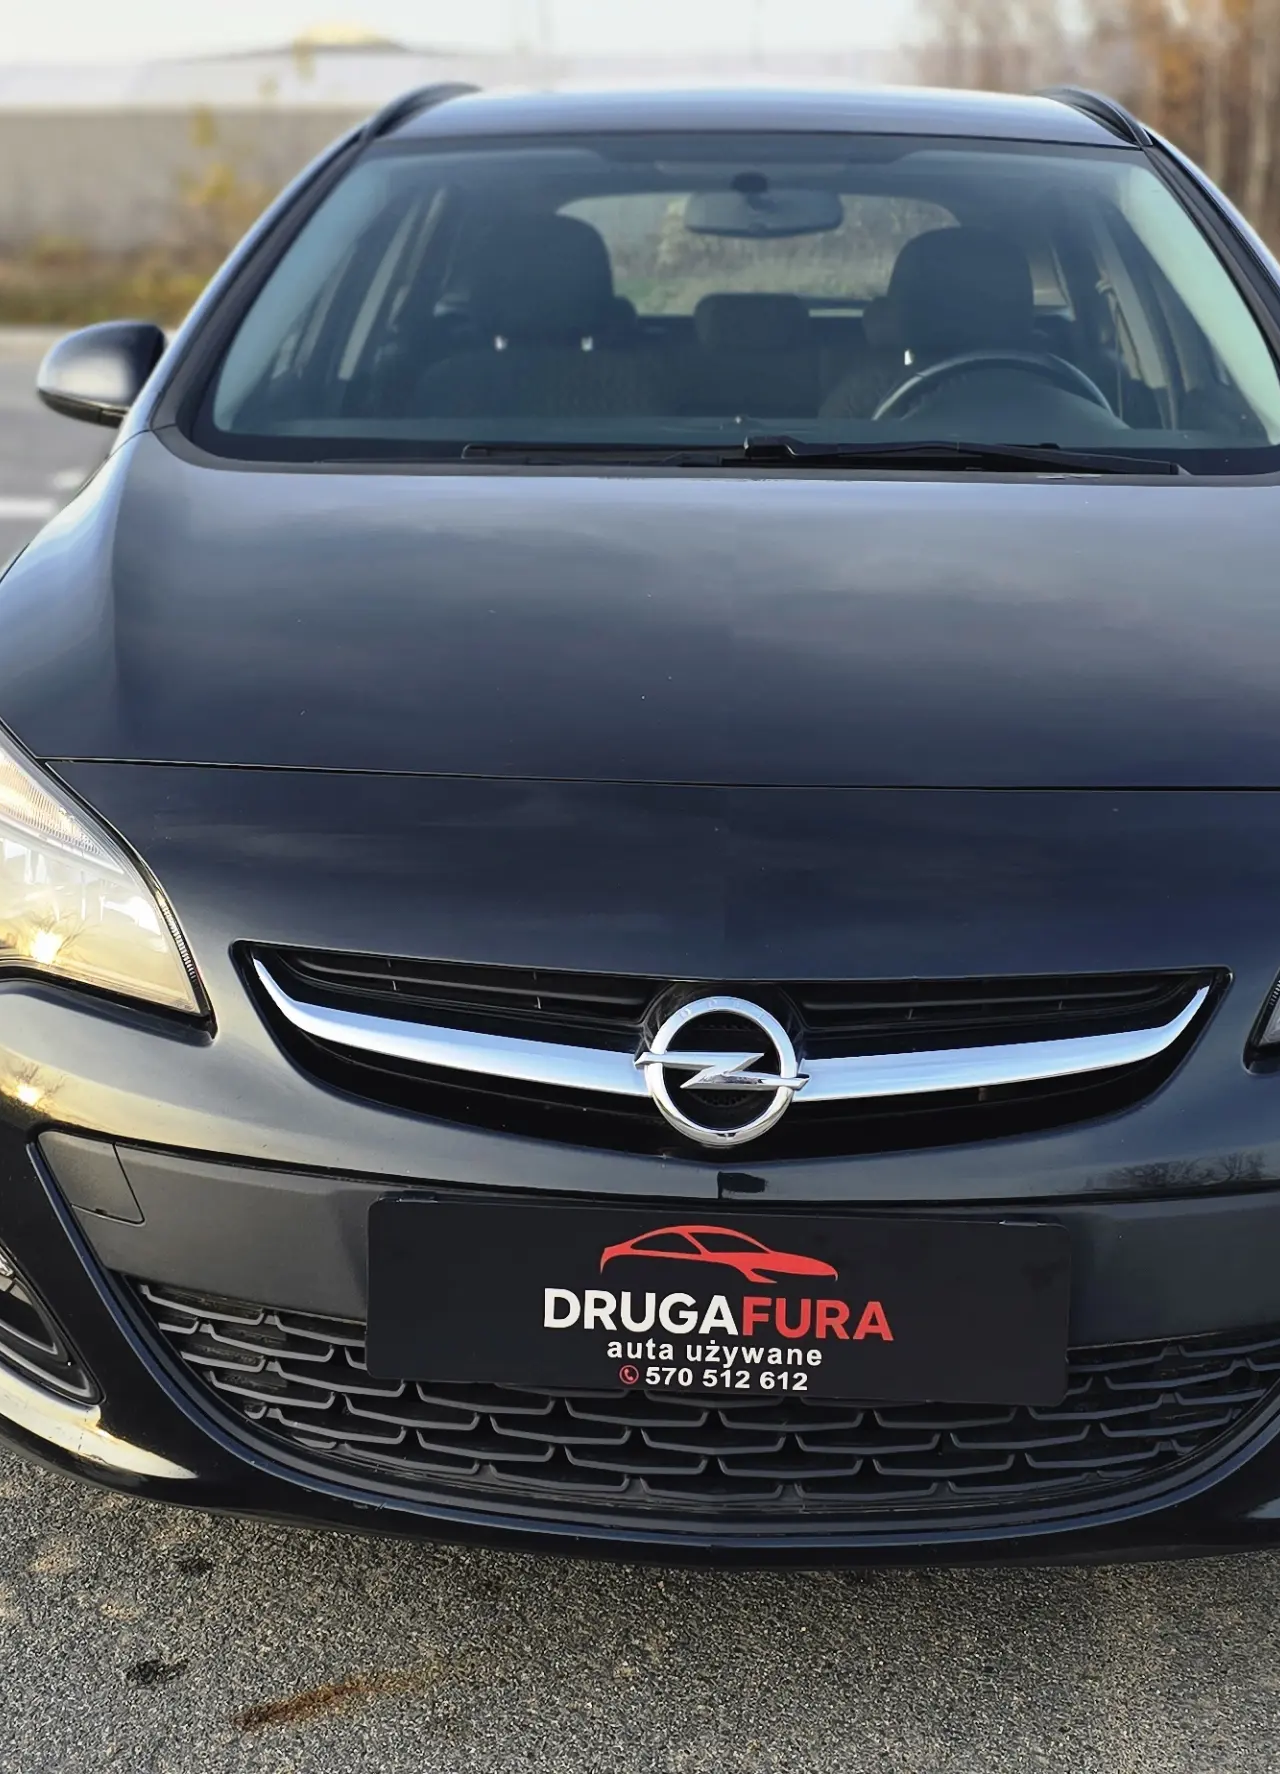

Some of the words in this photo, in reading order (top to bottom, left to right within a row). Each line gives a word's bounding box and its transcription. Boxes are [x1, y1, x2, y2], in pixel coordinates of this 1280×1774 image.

[543, 1287, 894, 1341] DRUGAFURA
[606, 1337, 674, 1361] auta
[686, 1339, 823, 1369] używane
[645, 1366, 693, 1387] 570
[702, 1368, 750, 1389] 512
[759, 1371, 808, 1391] 612
